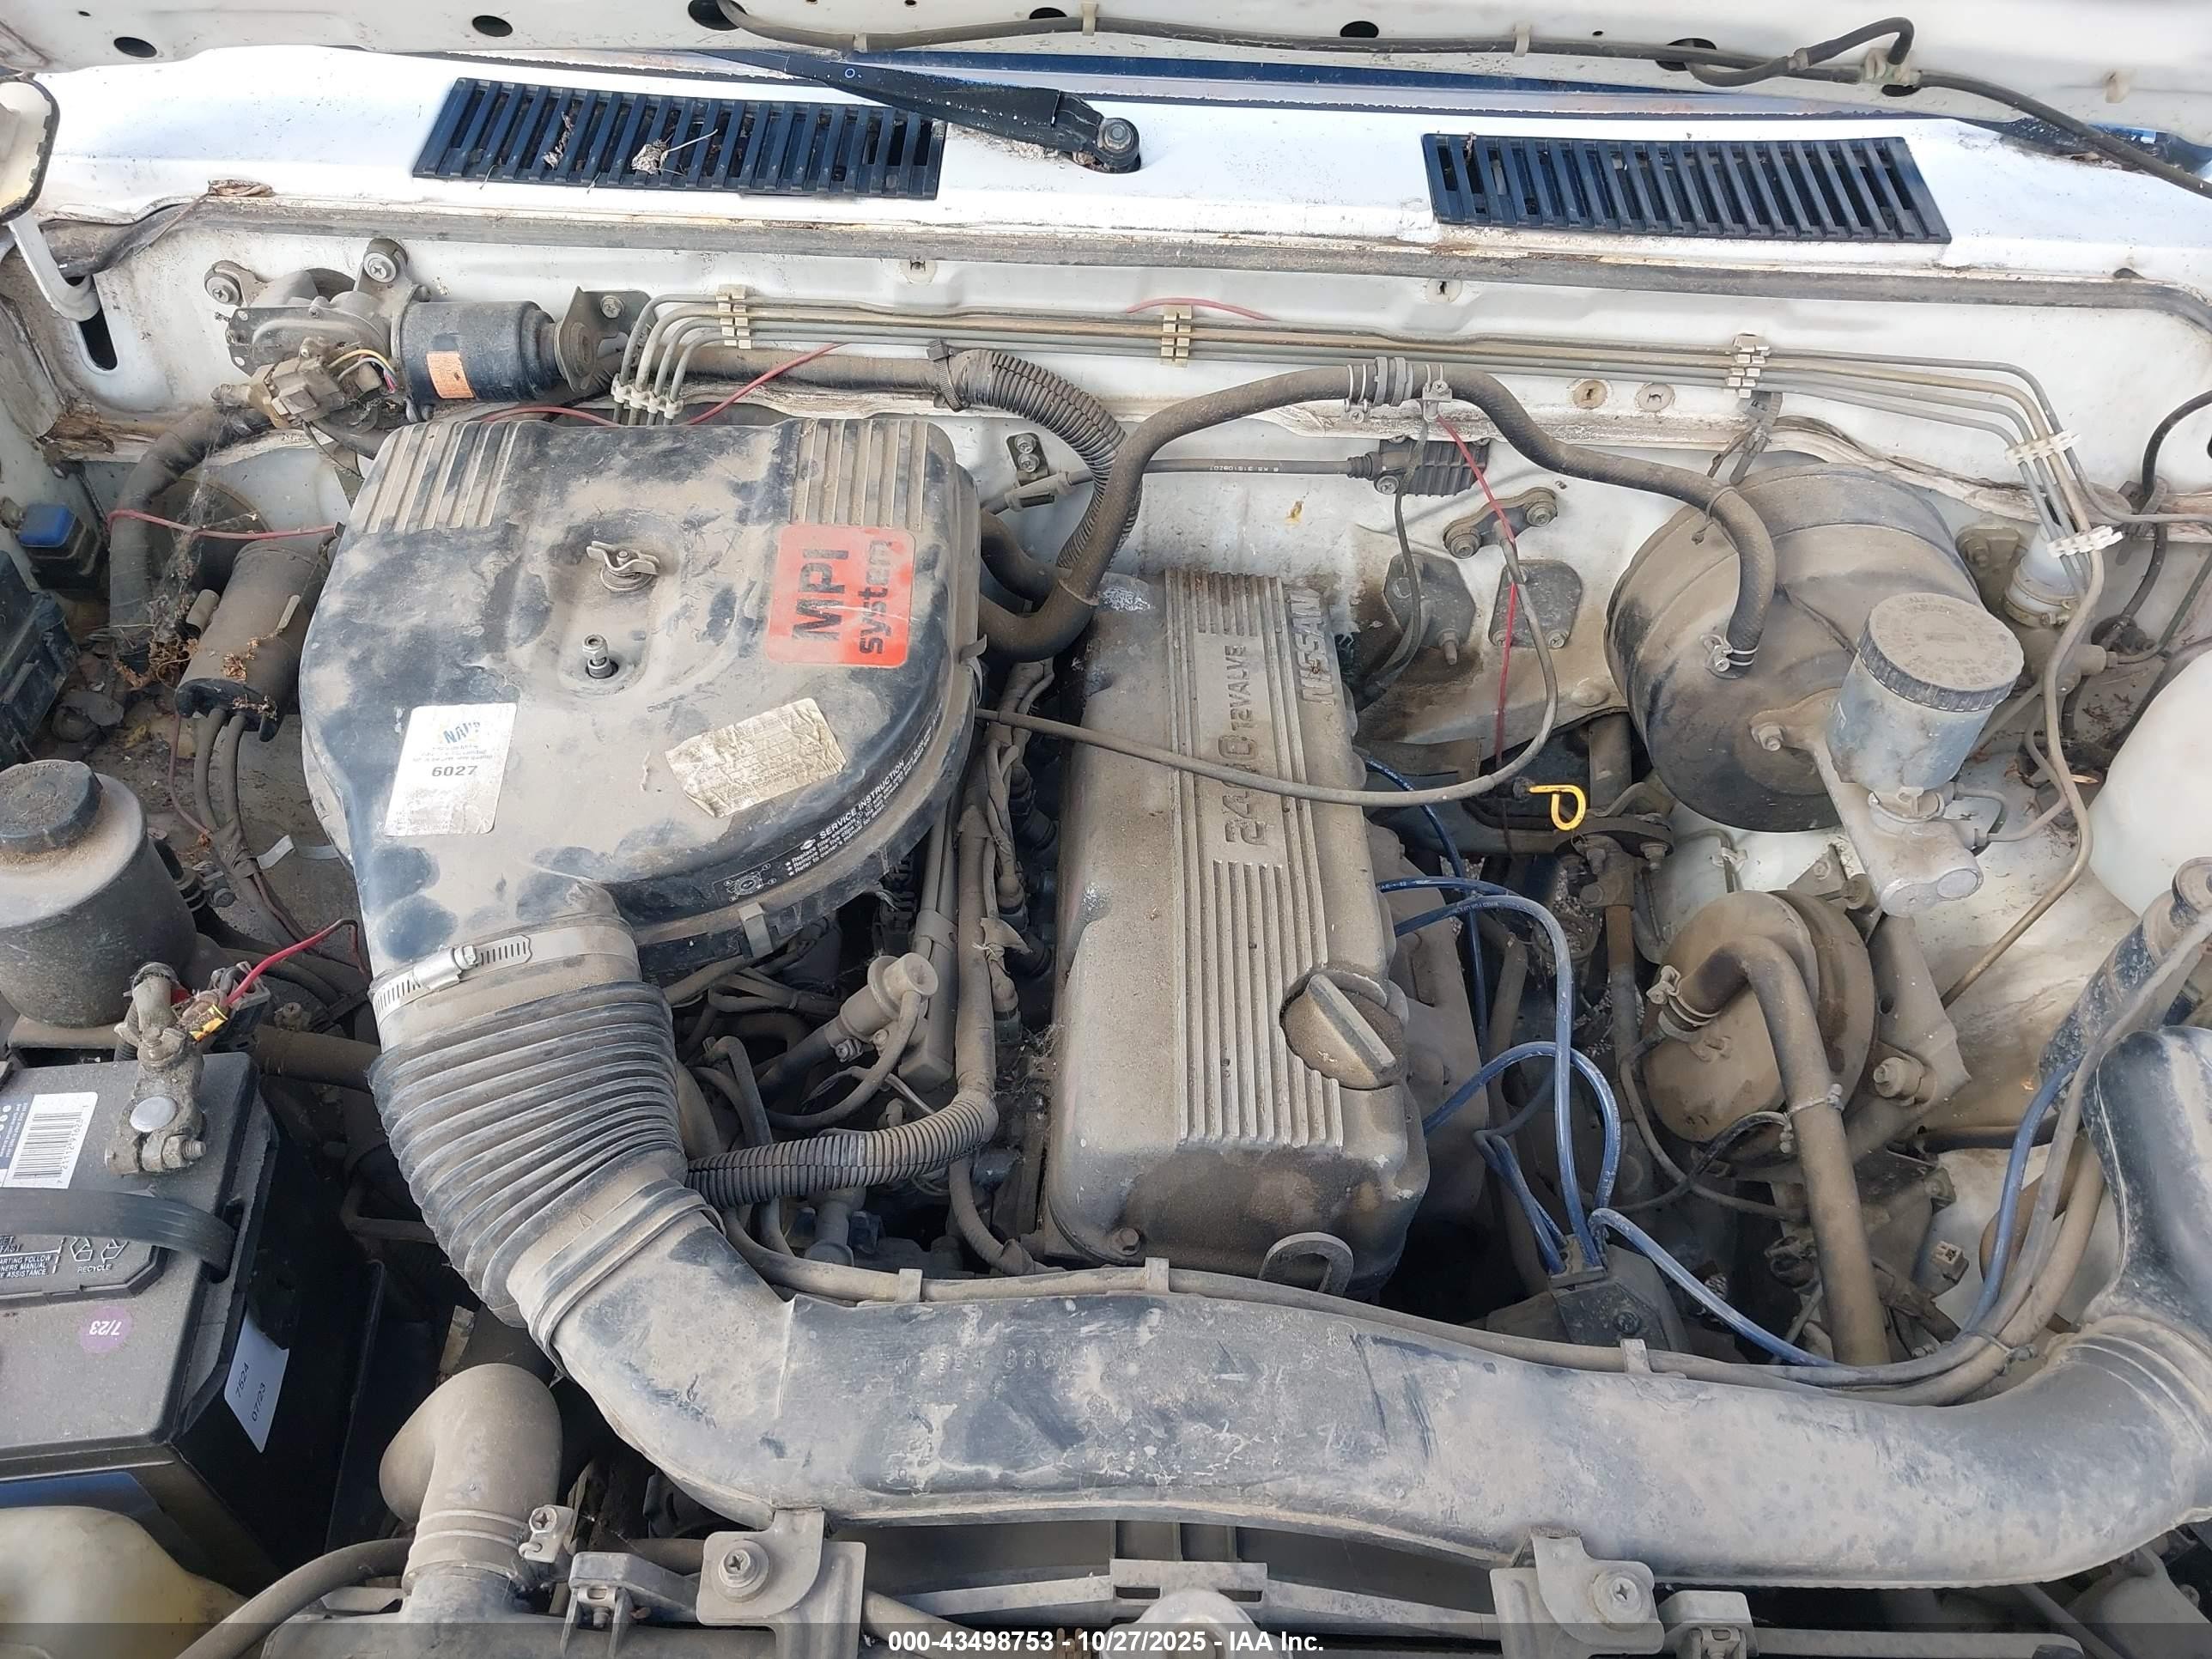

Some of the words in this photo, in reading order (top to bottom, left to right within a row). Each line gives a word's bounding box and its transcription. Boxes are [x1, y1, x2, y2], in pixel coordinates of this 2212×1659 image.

[792, 550, 848, 641] MPI
[859, 540, 893, 654] system
[1290, 588, 1336, 706] NISSAN
[432, 765, 478, 777] 6027
[1218, 734, 1268, 846] 240
[819, 809, 857, 840] SERVICE
[858, 759, 906, 811] INSTRUCTION
[792, 847, 817, 862] Replace
[817, 836, 831, 848] filter
[831, 817, 856, 839] elements
[794, 861, 812, 874] Refer
[820, 840, 843, 859] owner's
[843, 824, 863, 842] manual
[794, 850, 818, 868] Remove
[819, 843, 830, 853] the
[830, 836, 841, 847] five
[0, 1244, 21, 1254] FAST
[25, 1255, 52, 1263] FOLLOW
[77, 1264, 112, 1273] RECYCLE
[89, 1319, 122, 1336] 7/23
[252, 1382, 266, 1422] 07/23
